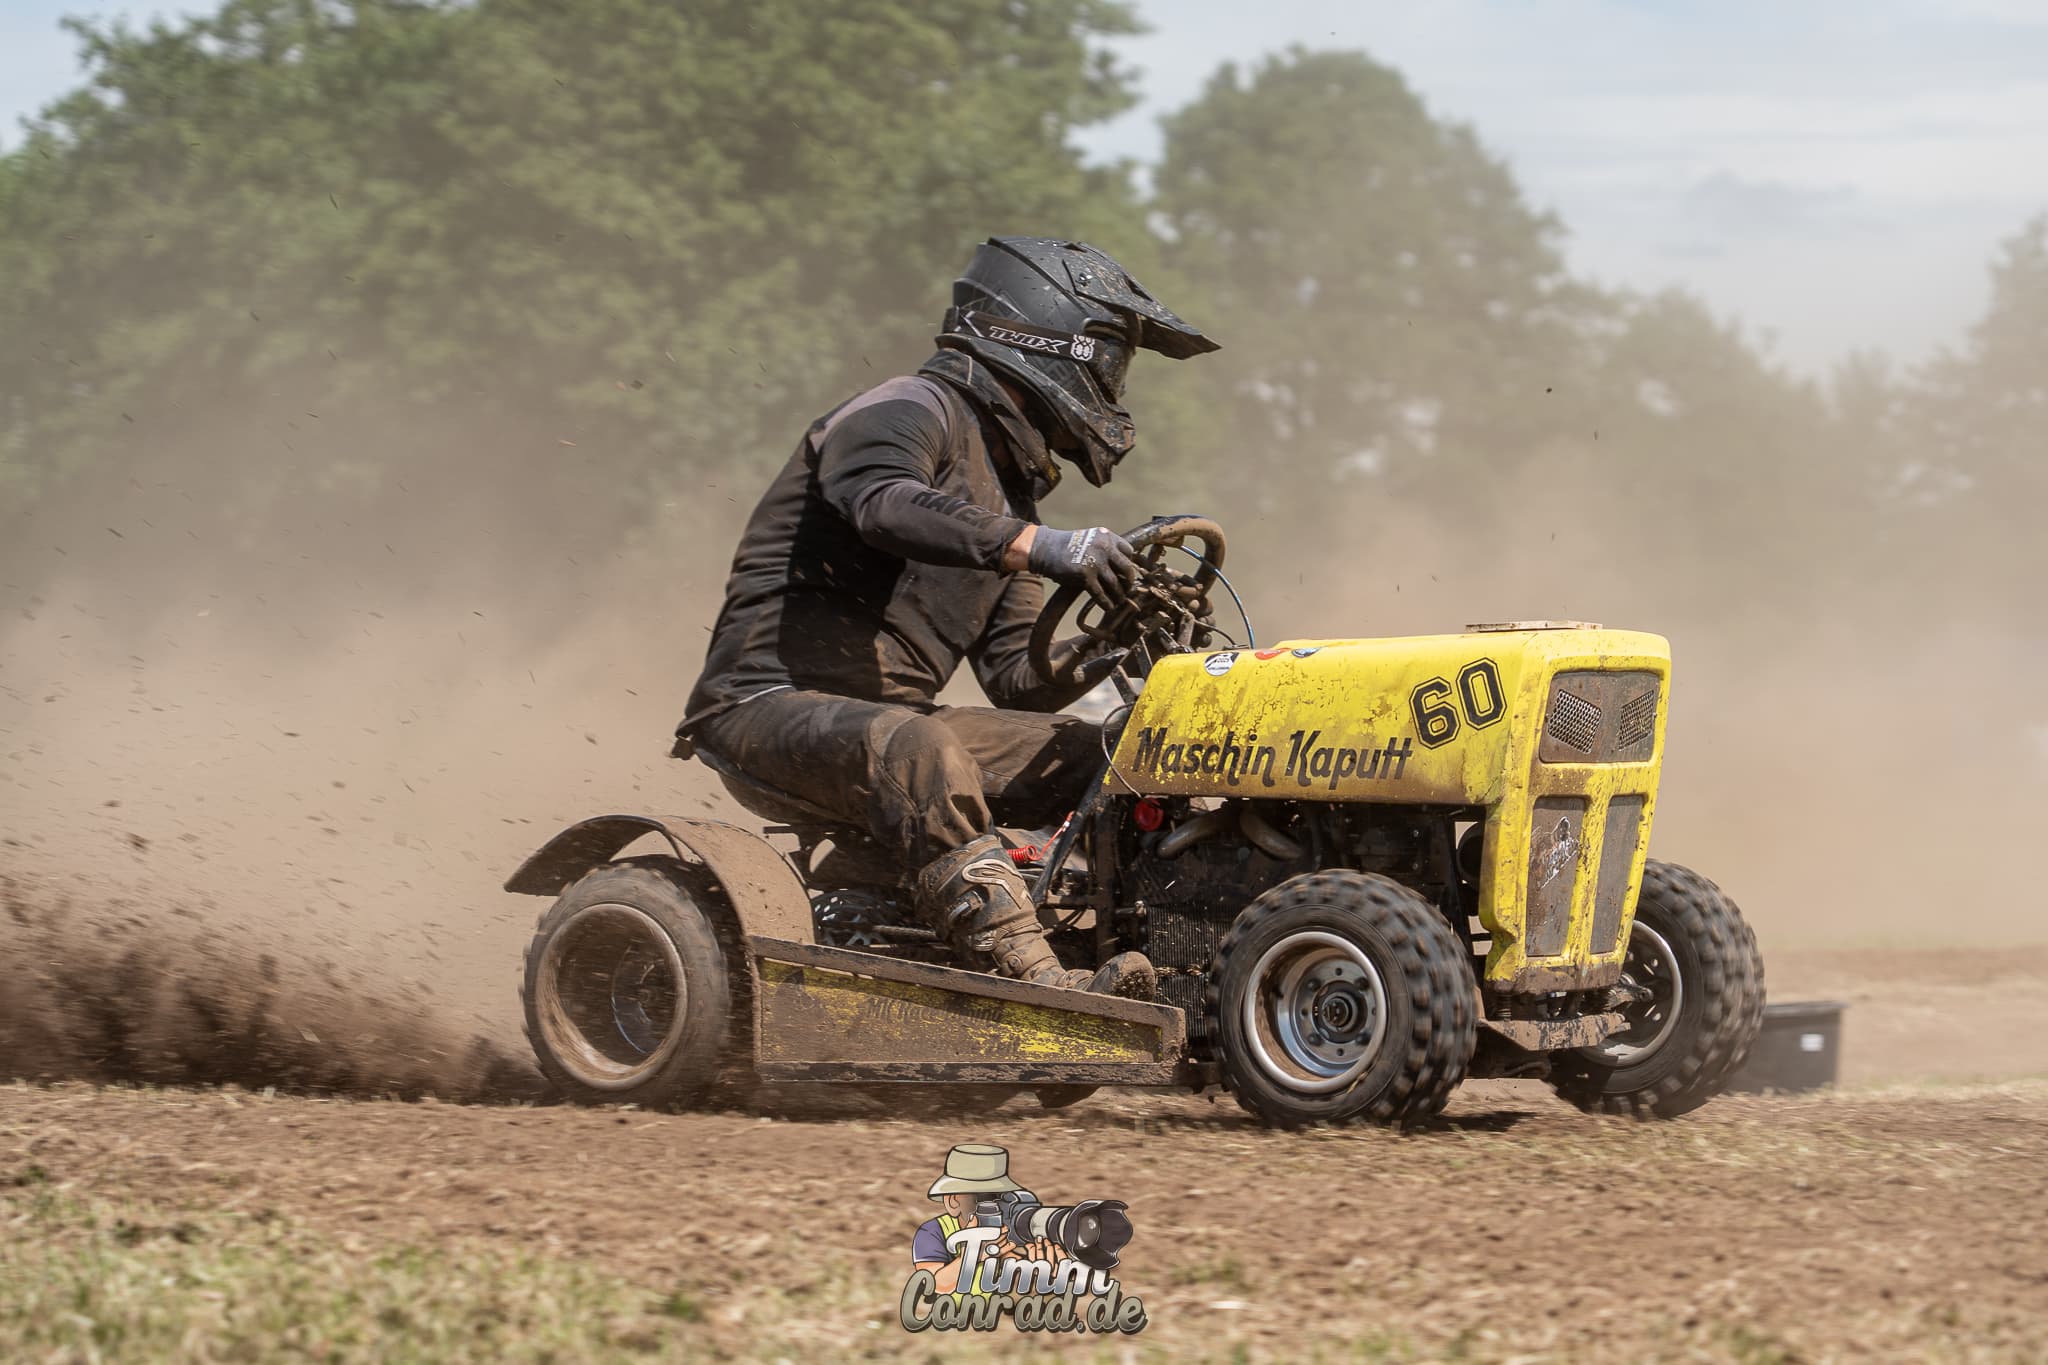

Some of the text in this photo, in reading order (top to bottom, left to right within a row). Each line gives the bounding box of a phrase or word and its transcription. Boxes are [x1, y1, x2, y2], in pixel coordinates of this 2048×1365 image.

[1408, 657, 1507, 750] 60
[1132, 726, 1413, 790] Maschin Kaputt
